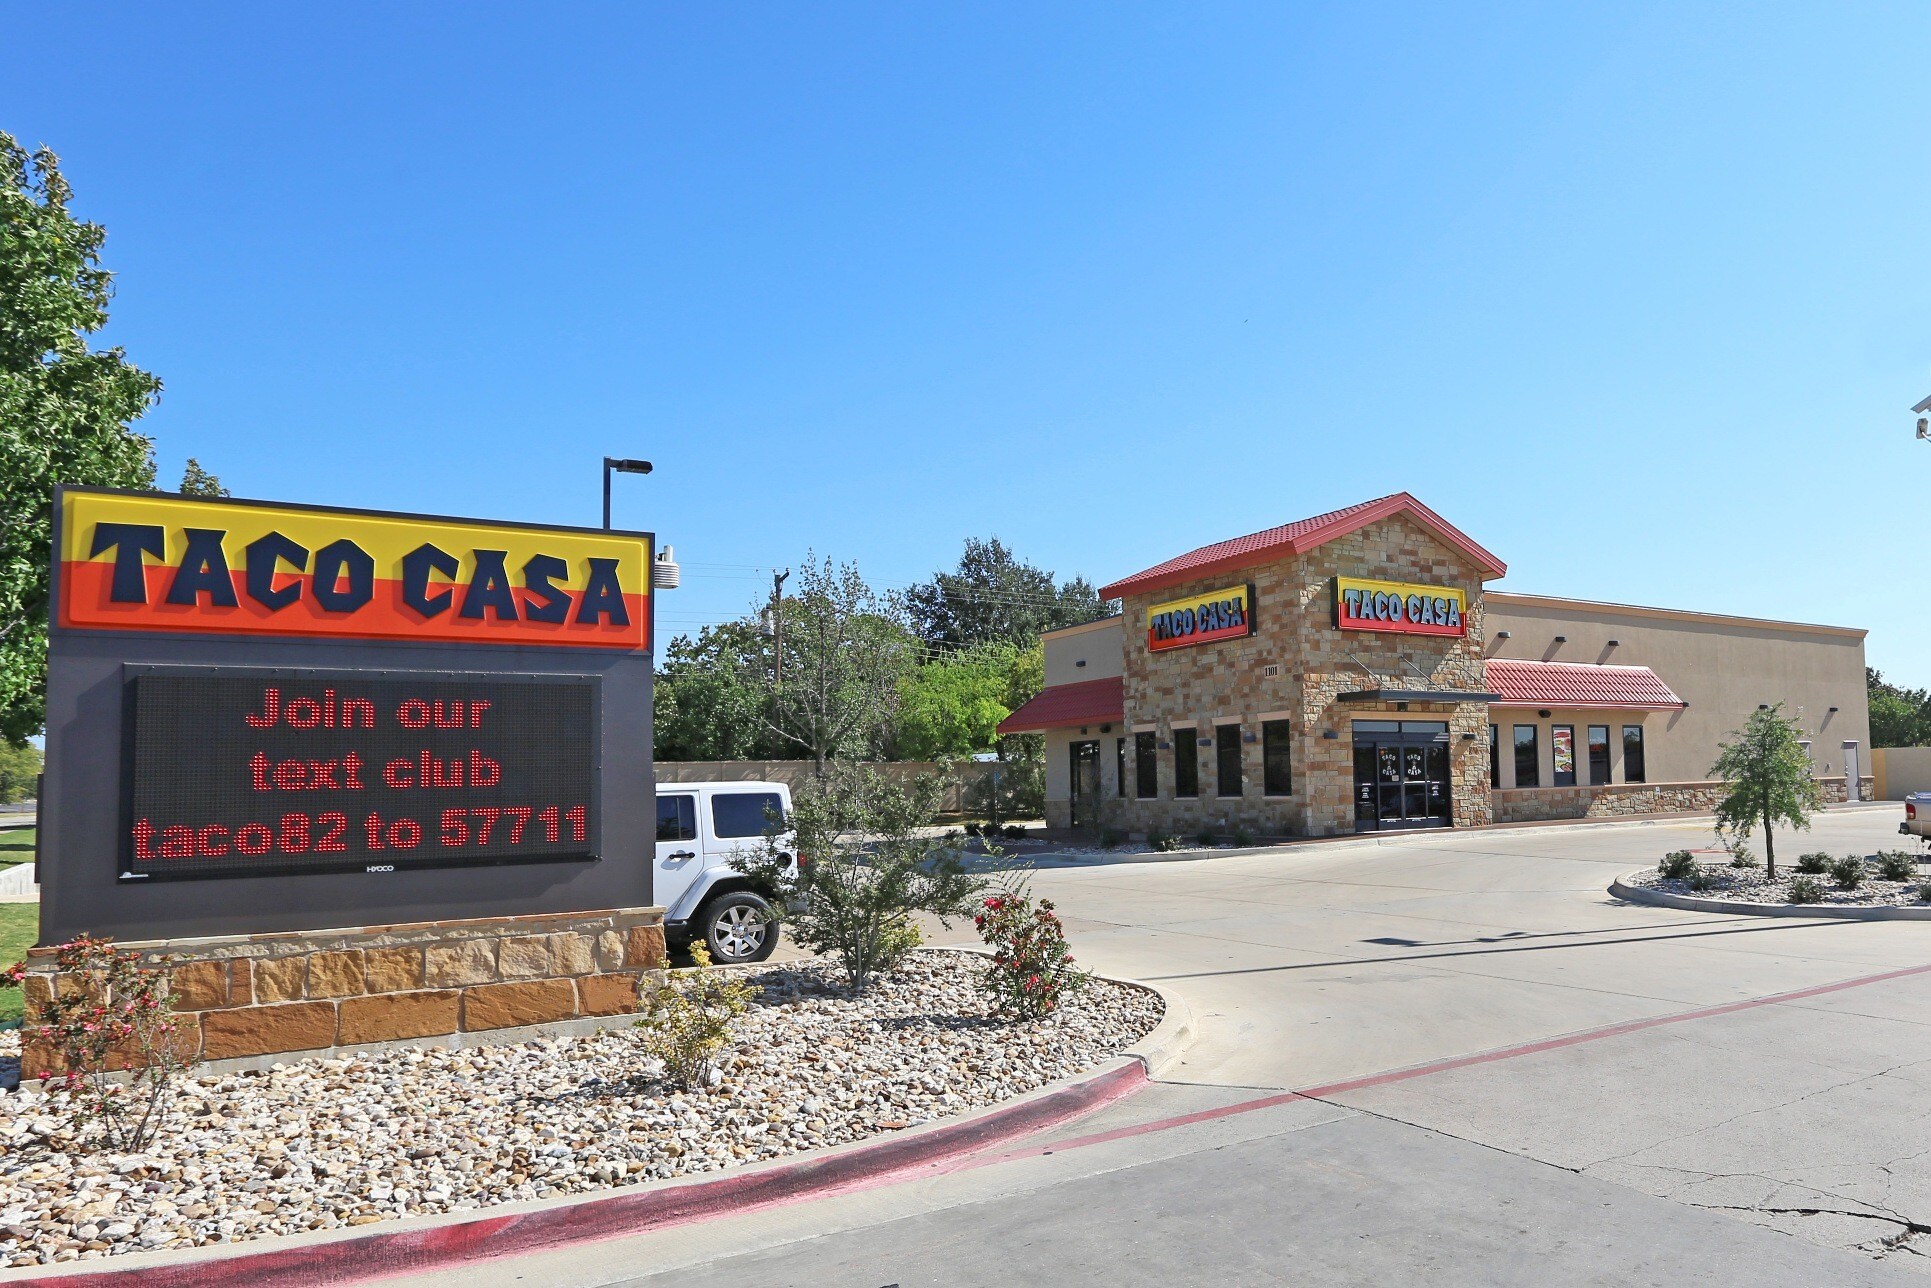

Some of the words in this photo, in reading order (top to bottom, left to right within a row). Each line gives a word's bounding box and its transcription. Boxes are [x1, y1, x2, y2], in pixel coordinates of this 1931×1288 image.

[89, 522, 375, 613] TACO
[402, 542, 631, 627] CASA
[1151, 608, 1195, 641] TACO
[1197, 597, 1242, 633] CASA
[1343, 588, 1403, 622] TACO
[1406, 593, 1461, 627] CASA
[1264, 665, 1278, 677] 1101
[246, 688, 375, 729] Join
[397, 698, 491, 729] our
[248, 751, 364, 791] text
[382, 749, 501, 788] club
[132, 812, 347, 860] taco82
[364, 811, 422, 850] to
[440, 806, 586, 847] 57711
